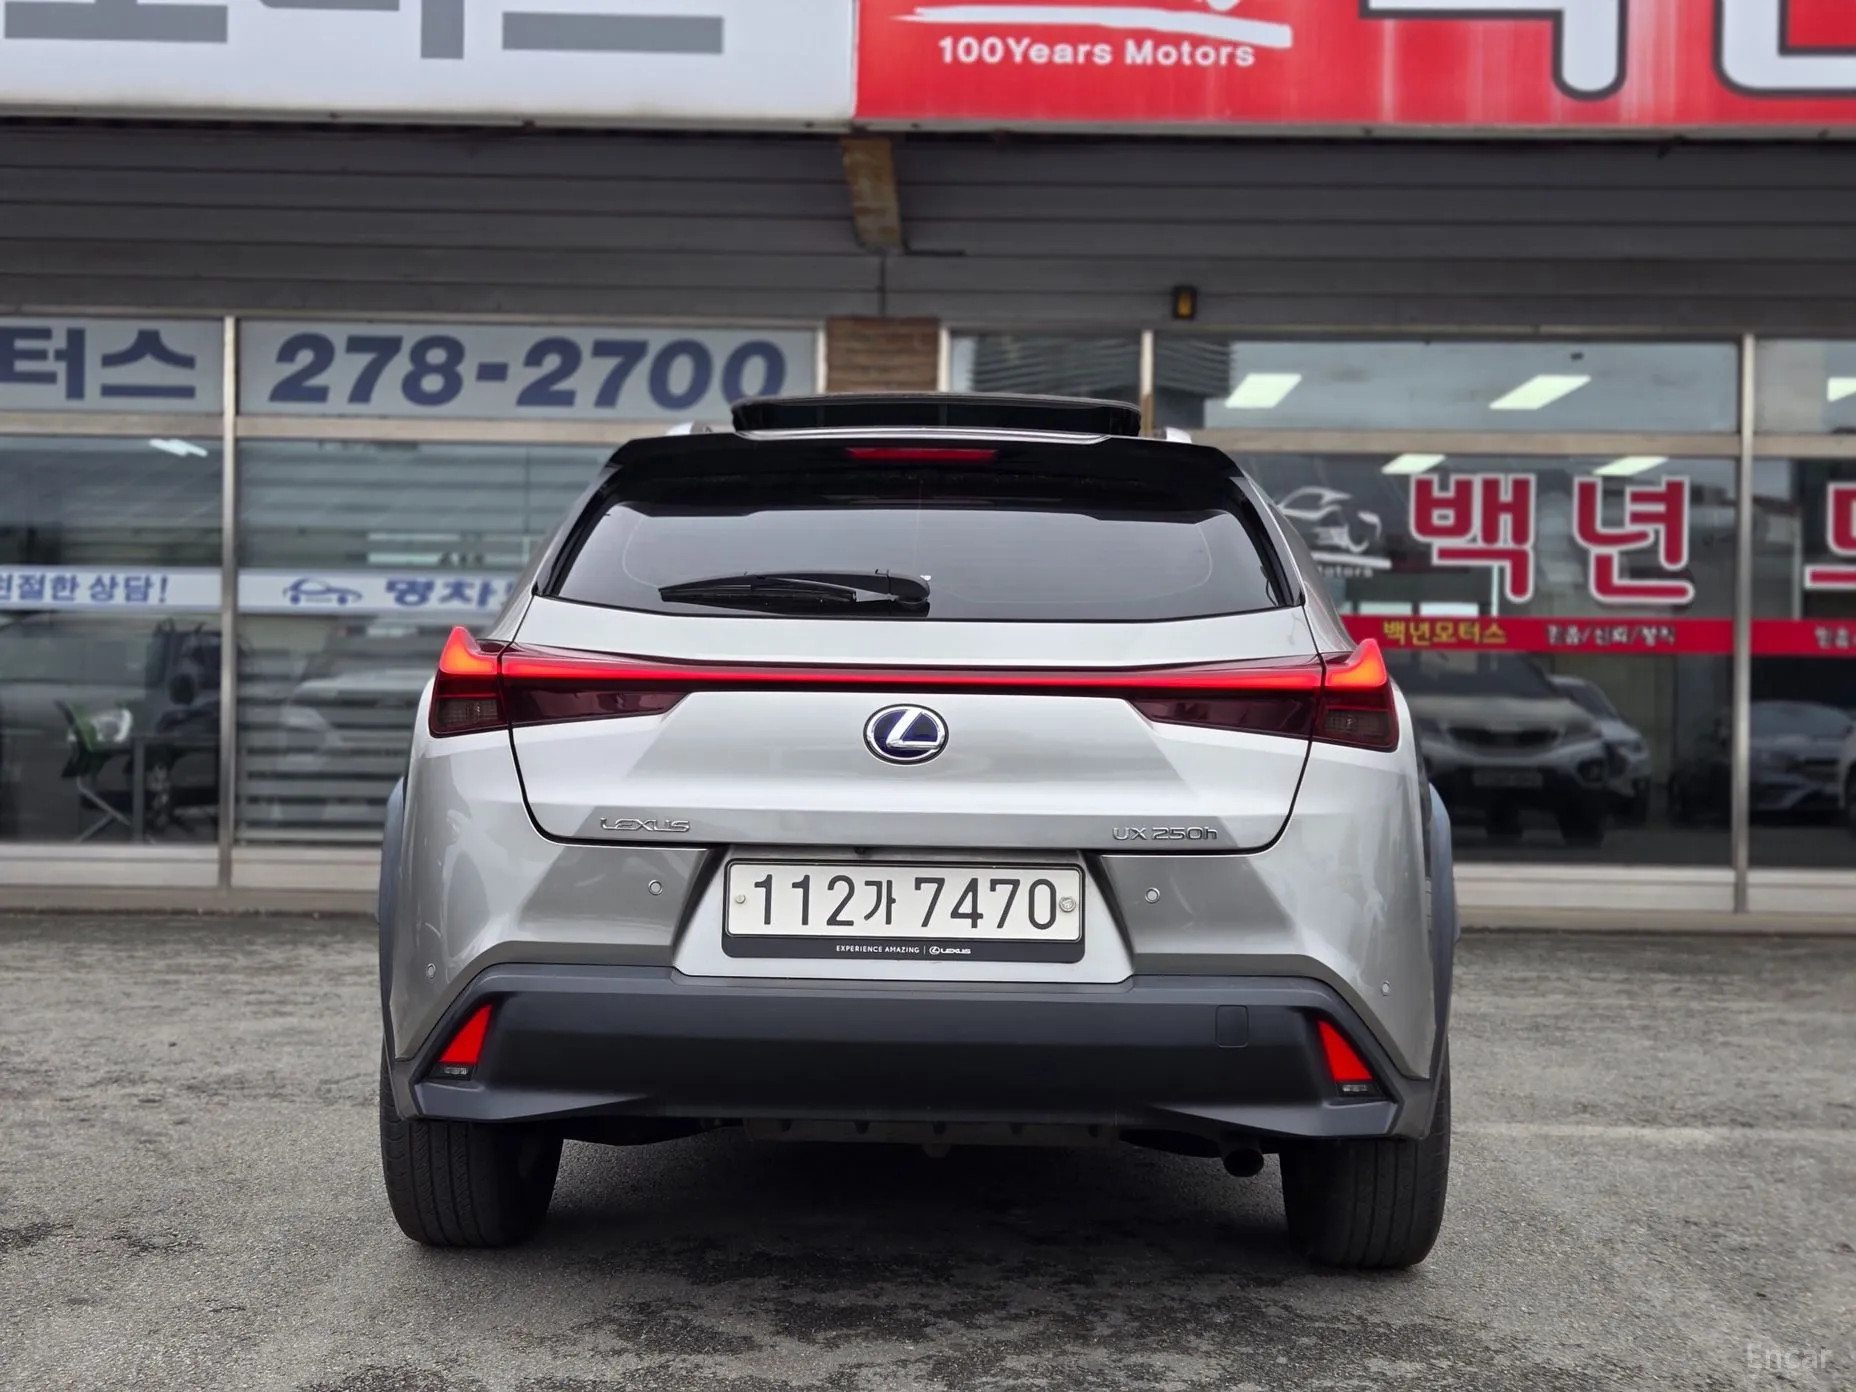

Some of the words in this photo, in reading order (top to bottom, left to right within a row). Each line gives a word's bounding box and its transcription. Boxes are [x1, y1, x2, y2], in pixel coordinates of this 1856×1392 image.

[938, 36, 1113, 65] 100Years
[1124, 39, 1256, 67] Motors
[268, 332, 787, 411] 278-2700
[89, 574, 168, 604] 상담!
[385, 578, 514, 608] 명차
[1383, 621, 1507, 645] 백년모터스
[600, 817, 690, 832] LEXUS
[1112, 827, 1147, 840] UX
[1152, 826, 1218, 840] 250h
[754, 873, 896, 927] 112가
[914, 876, 1057, 930] 7470
[836, 945, 883, 953] EXPERIENCE
[884, 946, 920, 954] AMAZING
